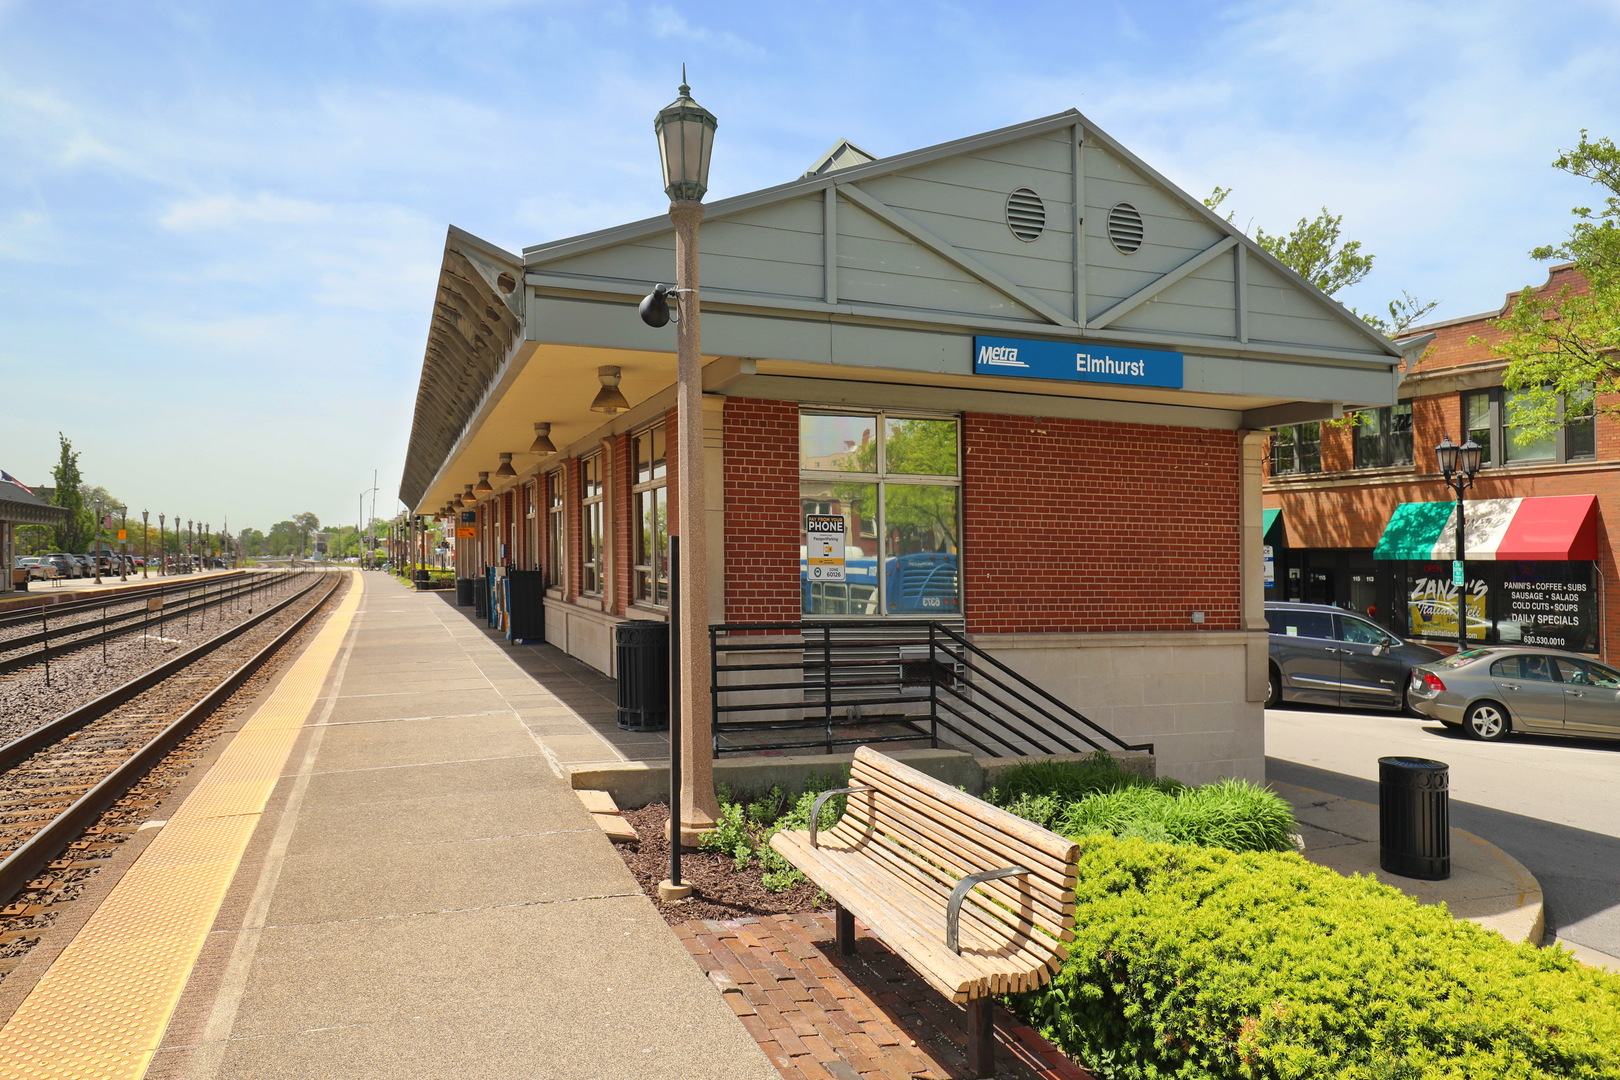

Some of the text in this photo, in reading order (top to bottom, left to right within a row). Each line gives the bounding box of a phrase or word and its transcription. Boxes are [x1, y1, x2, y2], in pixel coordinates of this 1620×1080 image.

[978, 345, 1145, 376] Metra Elmhurst
[808, 521, 843, 532] PHONE
[1424, 565, 1443, 573] OPEN
[1504, 582, 1587, 592] PANINI'S COFFEE SUBS
[1511, 591, 1579, 602] SAUSAGE SALADS
[1512, 601, 1579, 612] COLD CUTS SOUPS
[1511, 613, 1579, 626] DAILY SPECIALS
[1523, 635, 1565, 646] 630.530.0010
